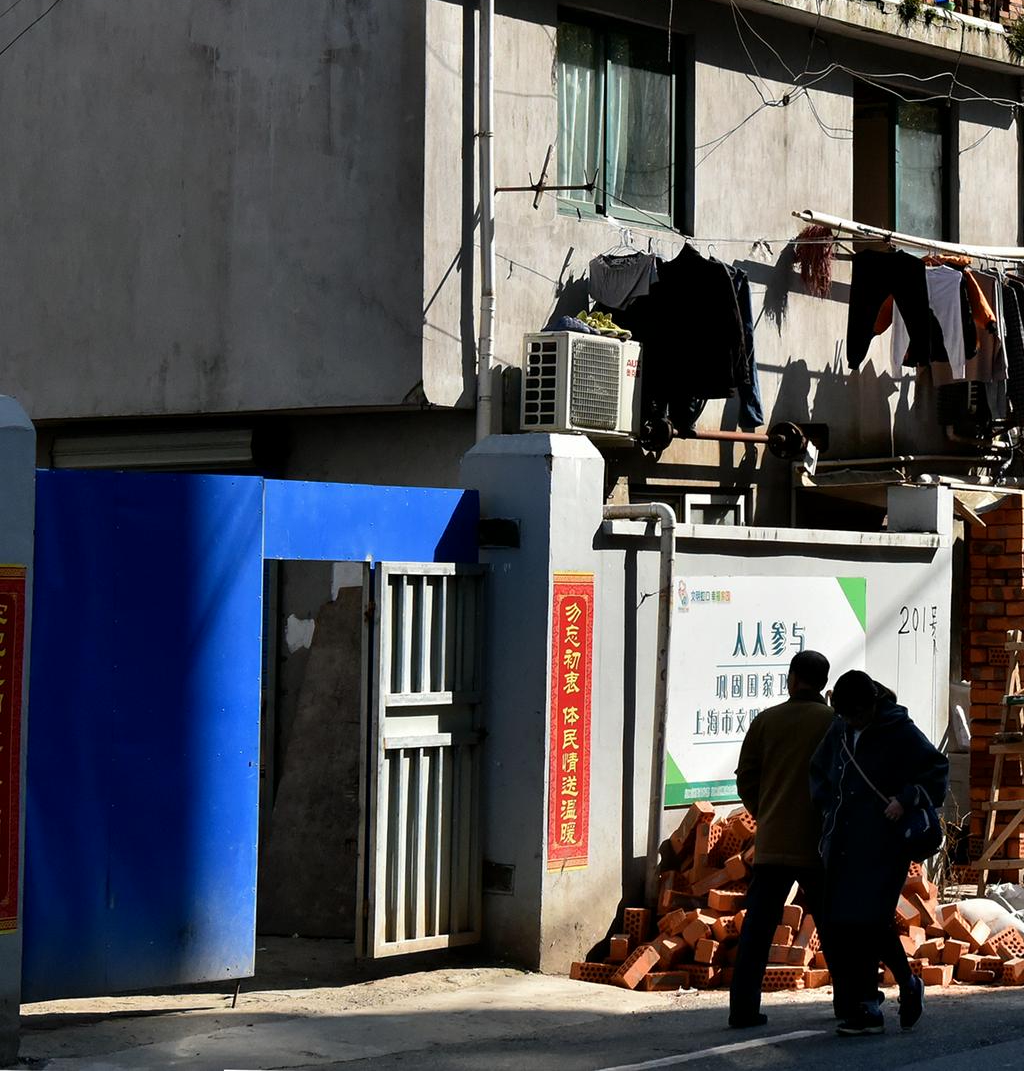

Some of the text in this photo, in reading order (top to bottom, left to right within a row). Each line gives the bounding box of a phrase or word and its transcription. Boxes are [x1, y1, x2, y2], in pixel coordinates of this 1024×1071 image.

[626, 359, 641, 368] AUX
[898, 605, 937, 637] 201号
[732, 620, 806, 657] 人人参与
[560, 602, 582, 844] 勿忘初衷 体民情送温暖
